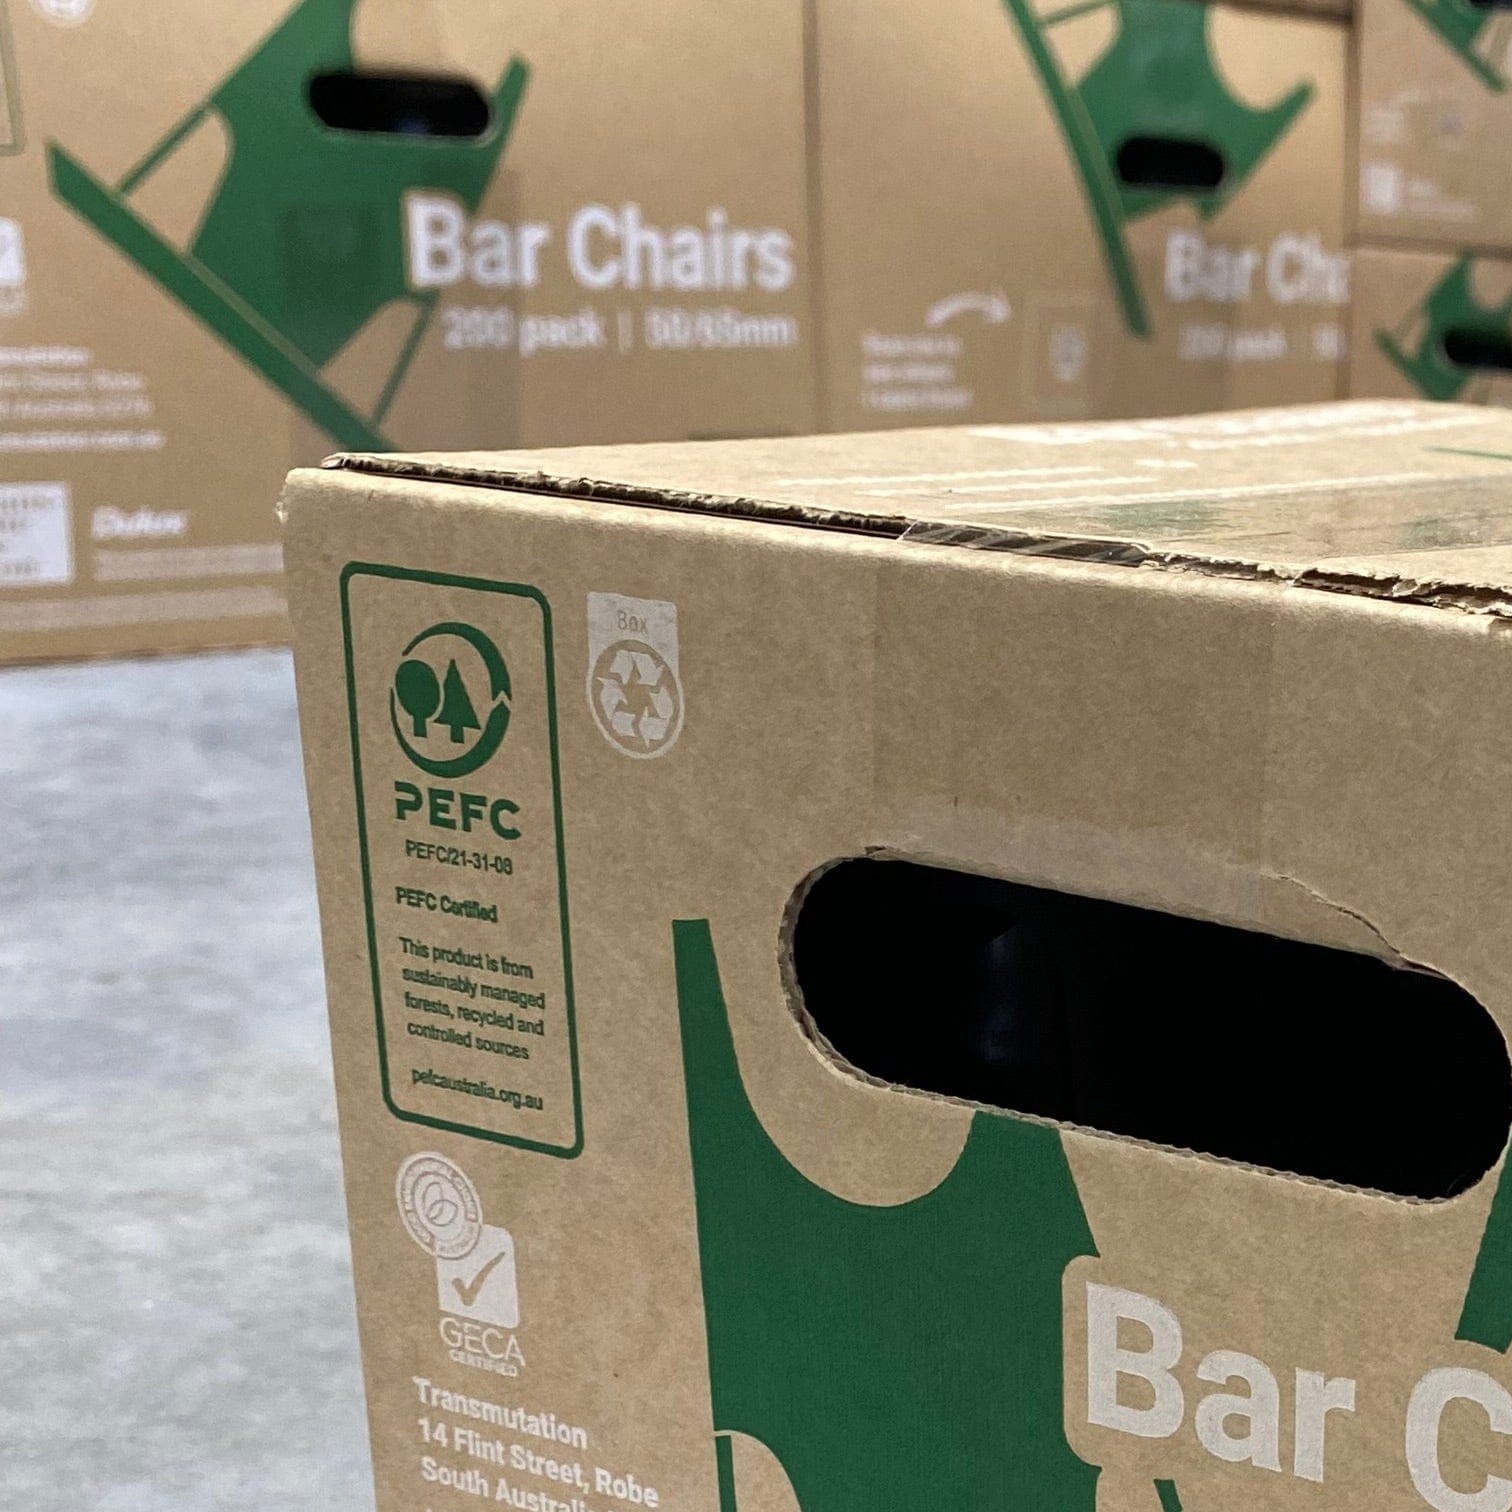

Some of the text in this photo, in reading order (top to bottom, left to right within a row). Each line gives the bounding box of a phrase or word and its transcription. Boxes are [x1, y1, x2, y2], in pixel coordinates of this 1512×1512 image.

[407, 197, 793, 291] Bar Chairs
[1165, 229, 1258, 302] Bar
[616, 611, 648, 635] Box
[394, 780, 522, 841] PEFC
[395, 886, 498, 923] PEFC Certified
[399, 937, 534, 979] This product is from
[402, 968, 545, 1010] sustainably managed
[404, 992, 545, 1036] forests, recycled and
[407, 1022, 530, 1059] controlled sources
[411, 1068, 543, 1110] pefcaustralia.org.au
[439, 1317, 526, 1367] GECA
[1085, 1280, 1356, 1484] Bar
[412, 1376, 588, 1450] Transmutation
[417, 1418, 659, 1509] 14 Flint Street, Robe
[421, 1457, 488, 1498] South
